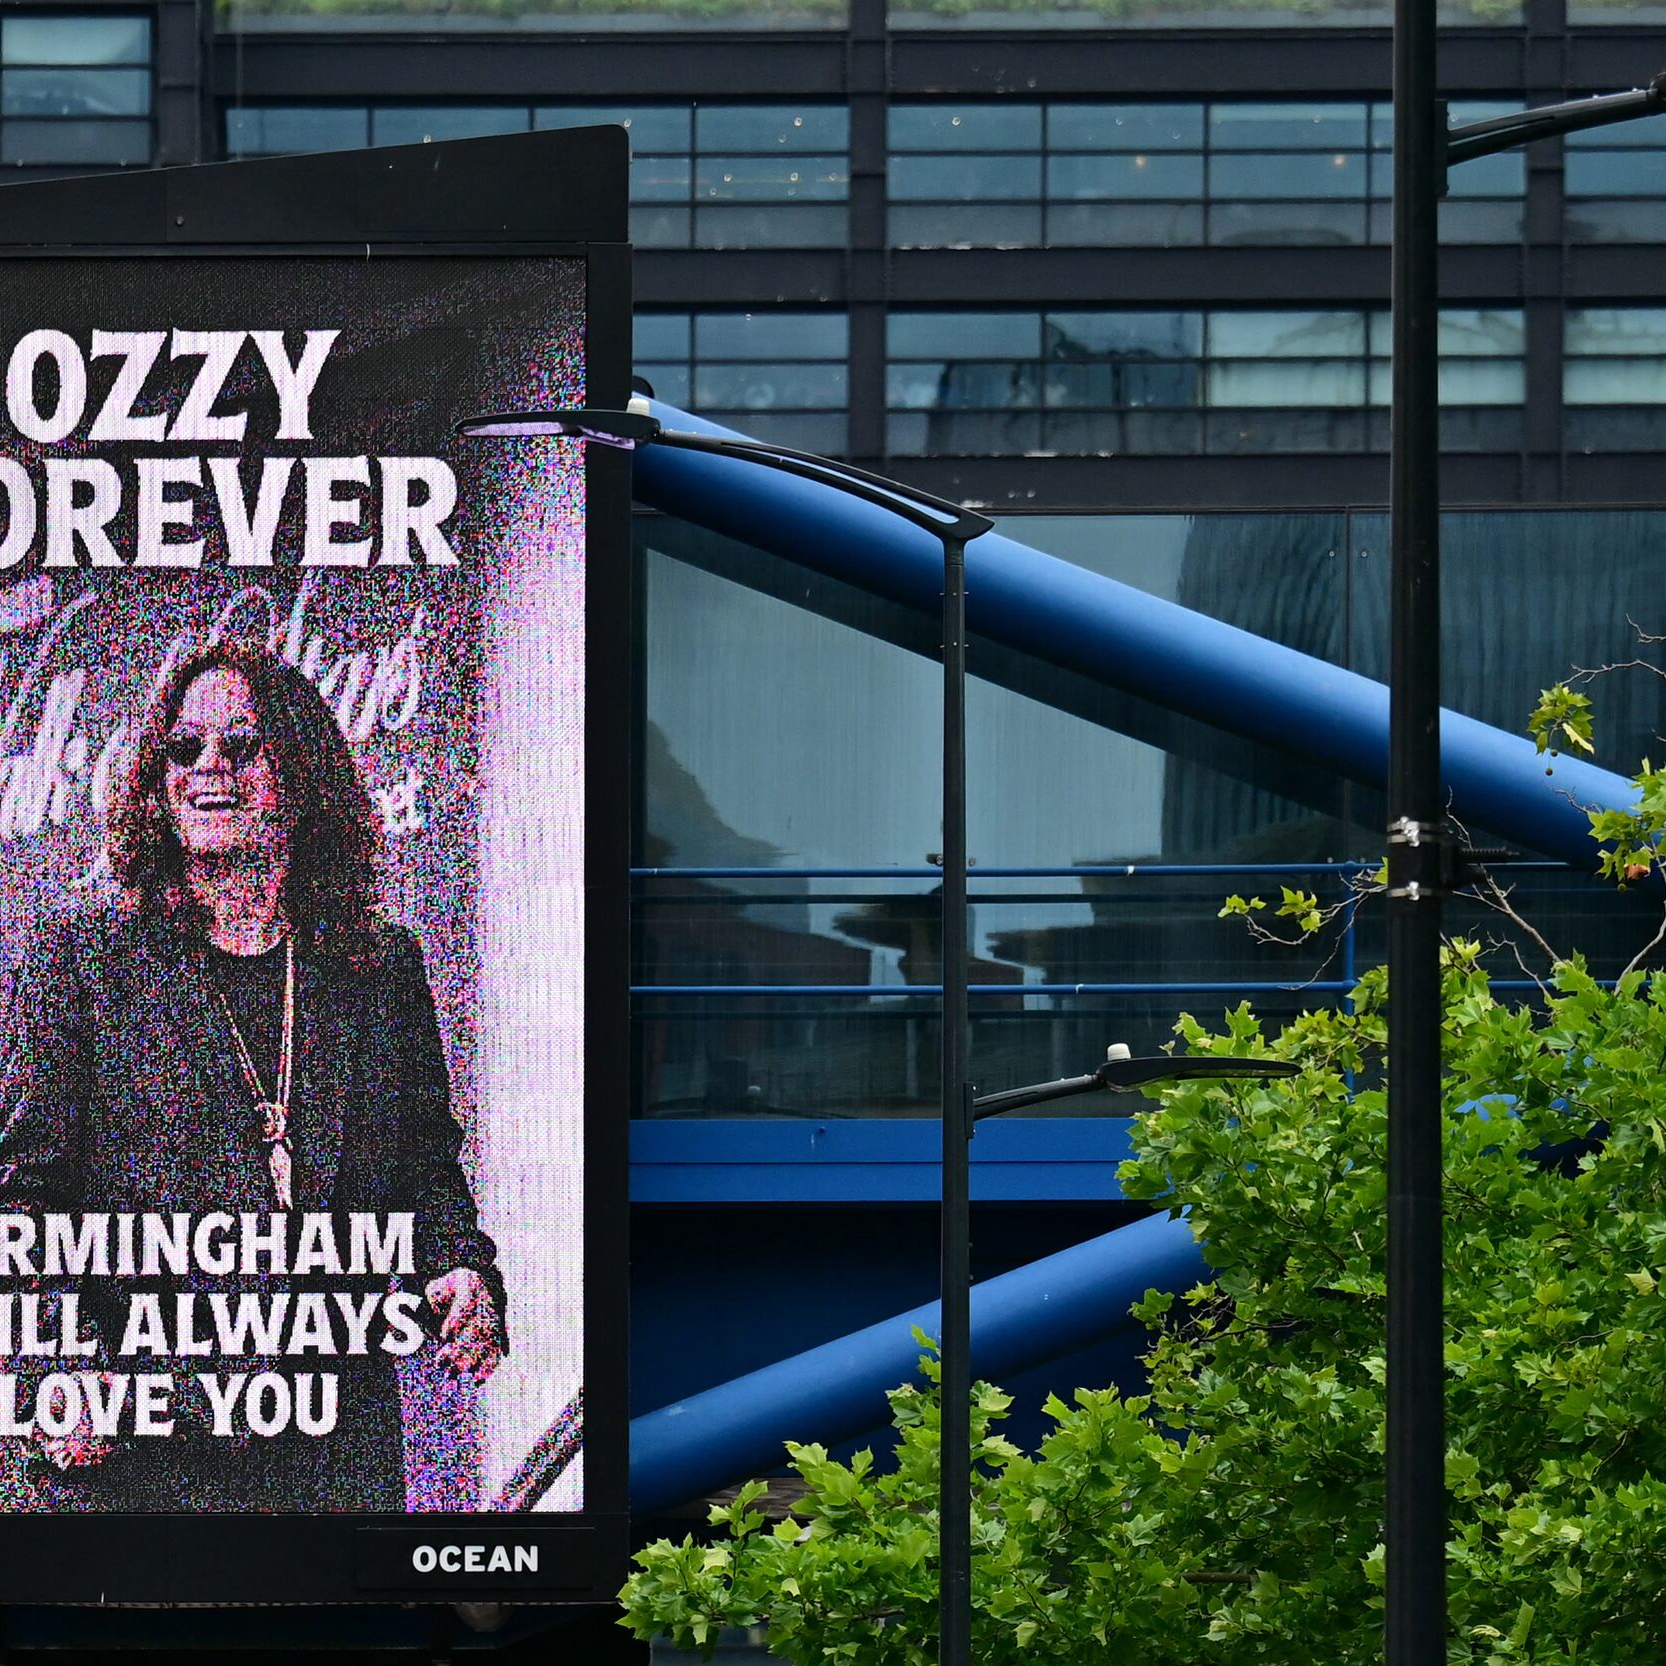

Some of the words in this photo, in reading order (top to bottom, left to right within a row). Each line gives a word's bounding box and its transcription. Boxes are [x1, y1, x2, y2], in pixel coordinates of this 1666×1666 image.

[5, 328, 342, 444] OZZY
[119, 1290, 425, 1358] ALWAYS
[205, 1372, 339, 1437] YOU
[412, 1544, 539, 1574] OCEAN
